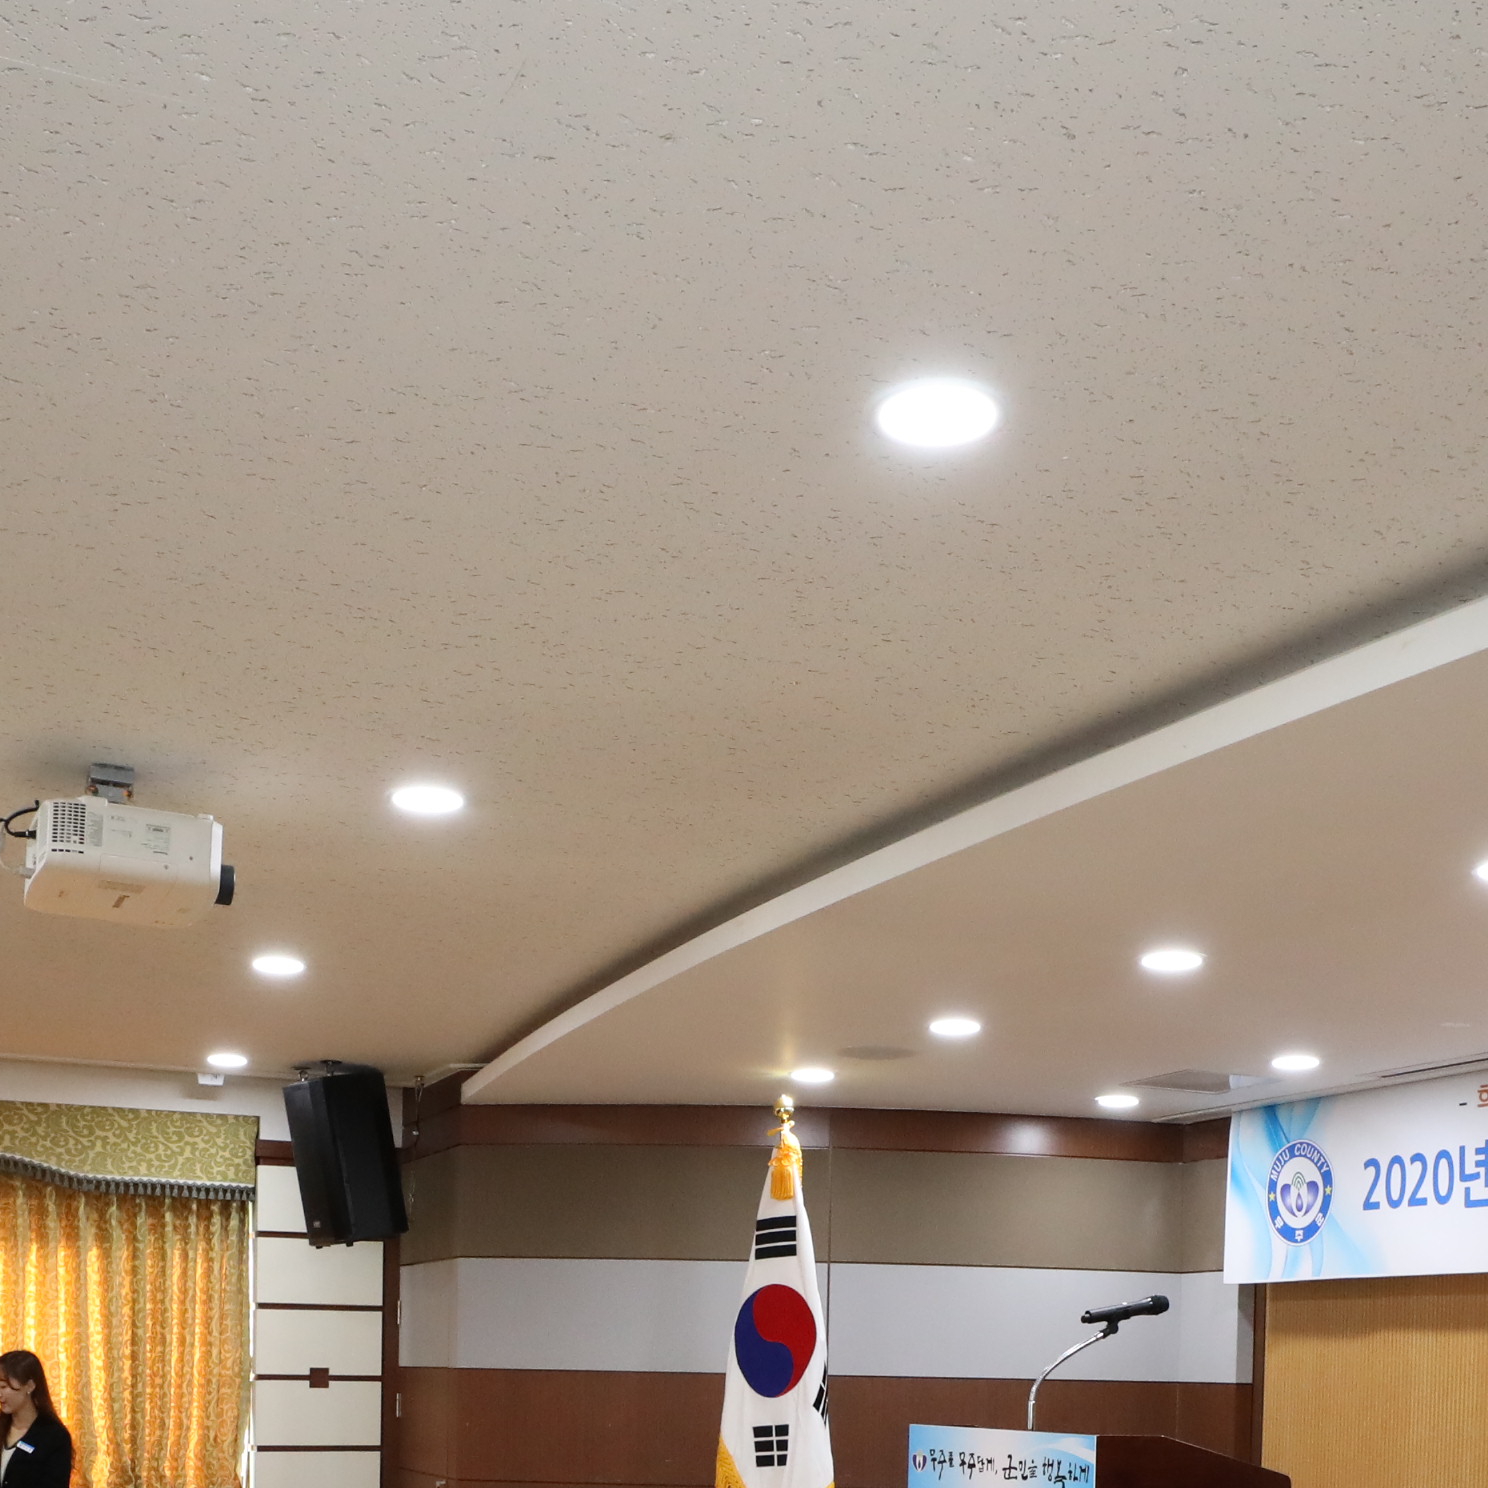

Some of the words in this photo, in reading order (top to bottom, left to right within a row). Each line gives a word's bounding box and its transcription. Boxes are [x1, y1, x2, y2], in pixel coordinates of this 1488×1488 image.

[1270, 1148, 1290, 1181] MUJU
[1294, 1143, 1330, 1174] COUNTY
[929, 1448, 955, 1481] 무주를
[1002, 1454, 1038, 1481] 군민을
